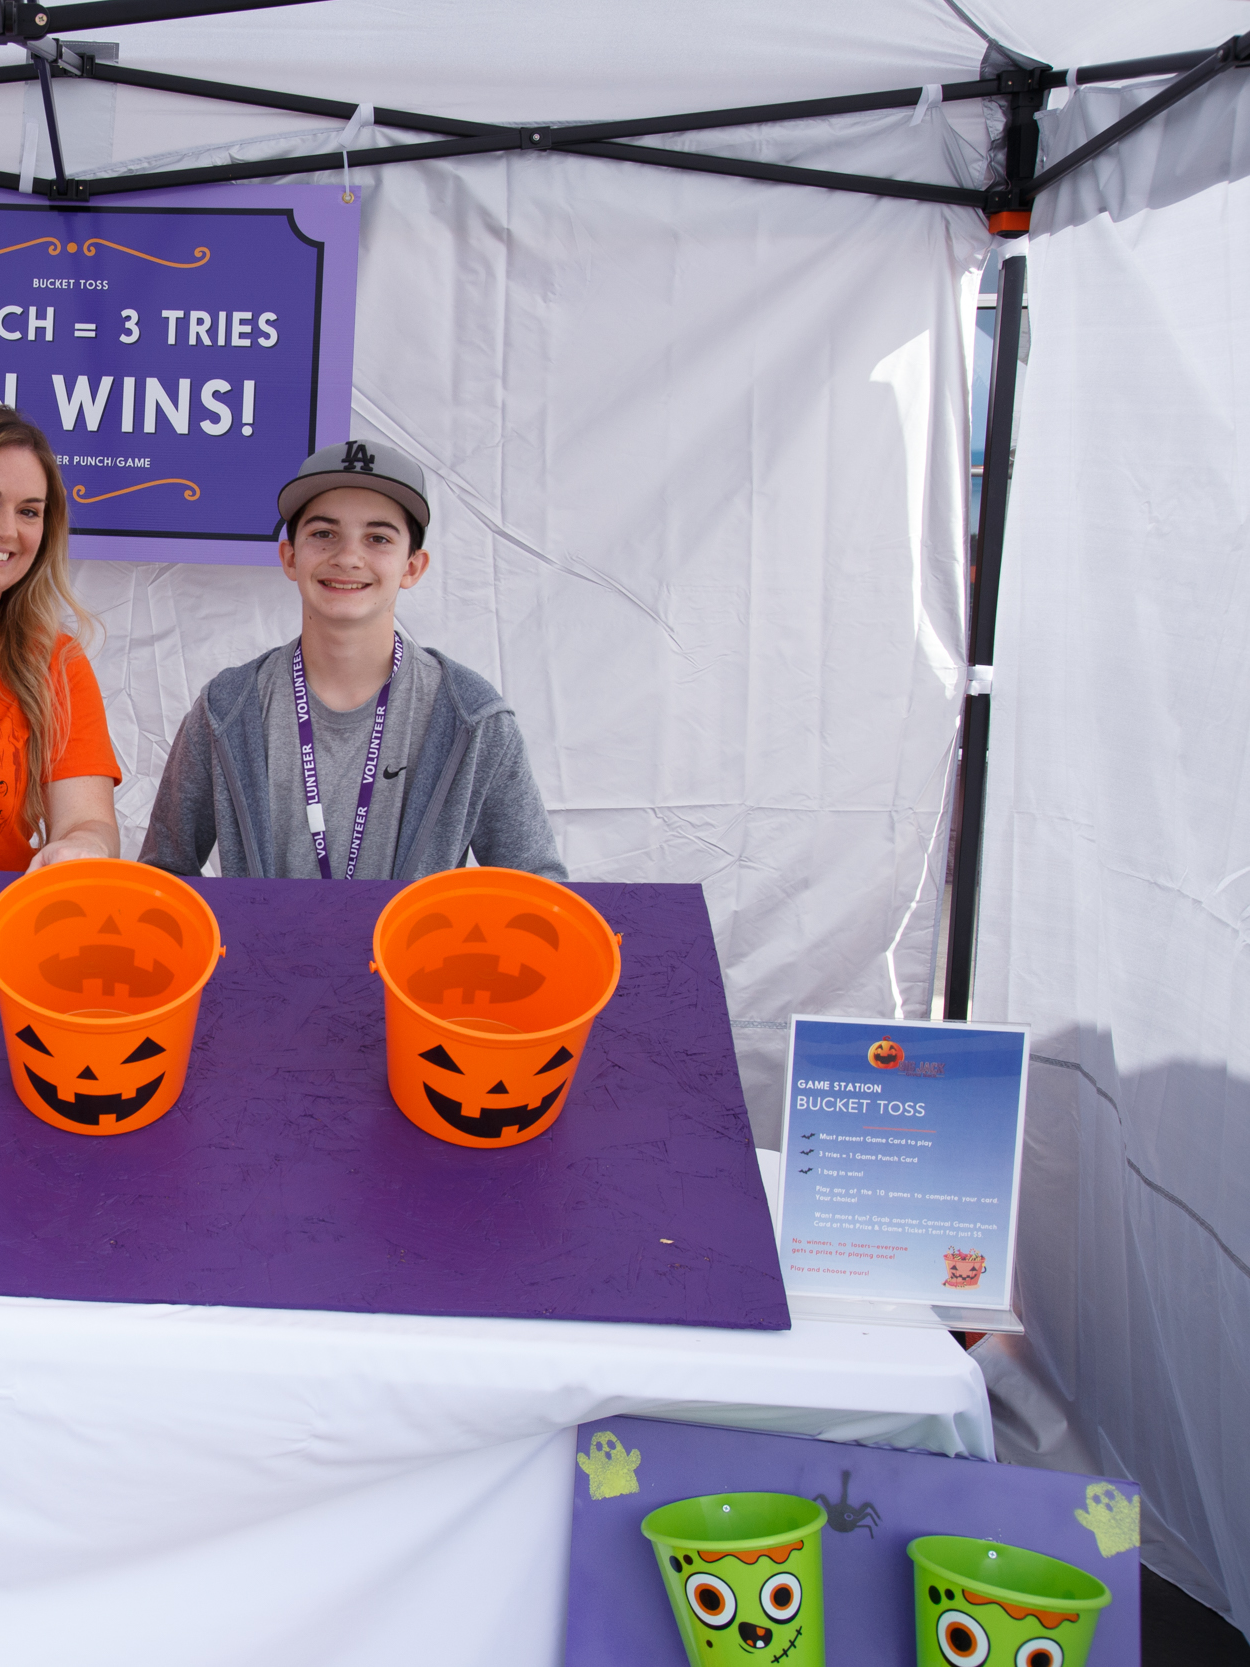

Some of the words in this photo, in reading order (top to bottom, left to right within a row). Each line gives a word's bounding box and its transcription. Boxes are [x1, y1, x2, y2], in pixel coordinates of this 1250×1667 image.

[33, 278, 74, 289] BUCKET
[80, 279, 108, 290] TOSS
[74, 322, 96, 338] =
[119, 308, 141, 344] 3
[162, 310, 279, 348] TRIES
[52, 374, 256, 437] WINS!
[55, 455, 69, 465] ER
[74, 456, 151, 468] PUNCH/GAME
[341, 440, 375, 472] LA
[293, 646, 309, 723] VOLUNTEER
[302, 743, 318, 804] LUNTEER
[363, 706, 385, 784] VOLUNTEER
[916, 1062, 946, 1074] JACK
[798, 1080, 830, 1090] GAME
[833, 1082, 882, 1093] STATION
[796, 1096, 870, 1113] BUCKET
[877, 1100, 925, 1117] TOSS
[866, 1136, 886, 1144] Game
[917, 1140, 932, 1148] play
[877, 1154, 898, 1162] Punch
[888, 1191, 910, 1199] games
[925, 1193, 958, 1201] complete
[855, 1214, 870, 1222] fun?
[892, 1217, 919, 1225] another
[922, 1219, 951, 1227] Carnival
[953, 1221, 974, 1229] Game
[976, 1222, 997, 1230] Punch
[814, 1220, 830, 1228] Card
[882, 1225, 902, 1233] Game
[958, 1230, 971, 1238] just
[848, 1251, 874, 1259] playing
[790, 1264, 805, 1272] Play
